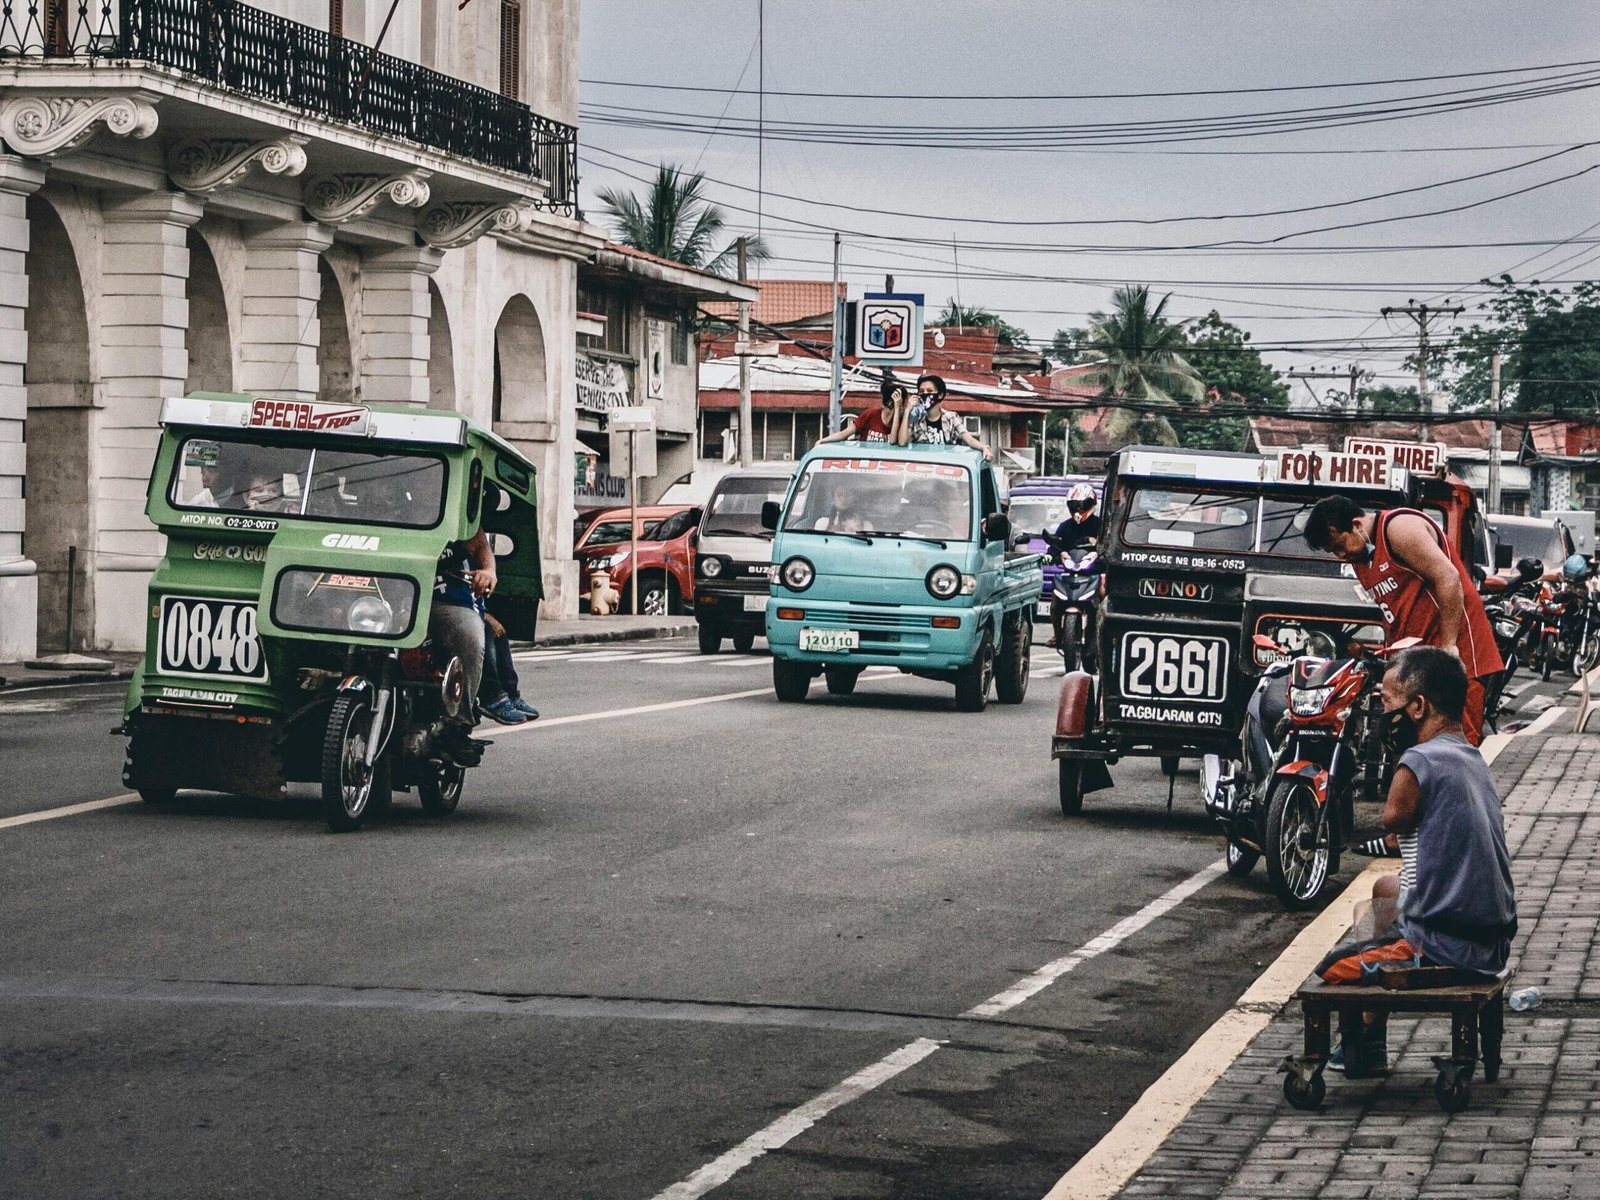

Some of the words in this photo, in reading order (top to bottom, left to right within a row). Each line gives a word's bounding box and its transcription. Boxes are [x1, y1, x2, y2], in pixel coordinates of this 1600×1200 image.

[250, 400, 317, 430] SPECIAL
[314, 408, 365, 430] TRIP
[821, 459, 964, 478] RUSCO
[1280, 453, 1323, 481] FOR
[1329, 456, 1387, 485] HIRE
[1393, 447, 1435, 472] HIRE
[606, 473, 626, 498] CLUB
[180, 514, 206, 525] MTOP
[321, 533, 380, 551] GINA
[1121, 552, 1148, 562] MTOP
[1149, 555, 1172, 564] CASE
[165, 601, 260, 674] 0848
[1129, 636, 1220, 697] 2661
[215, 692, 239, 703] CITY
[1119, 704, 1194, 723] TAGBILARAN
[1197, 711, 1222, 725] CITY
